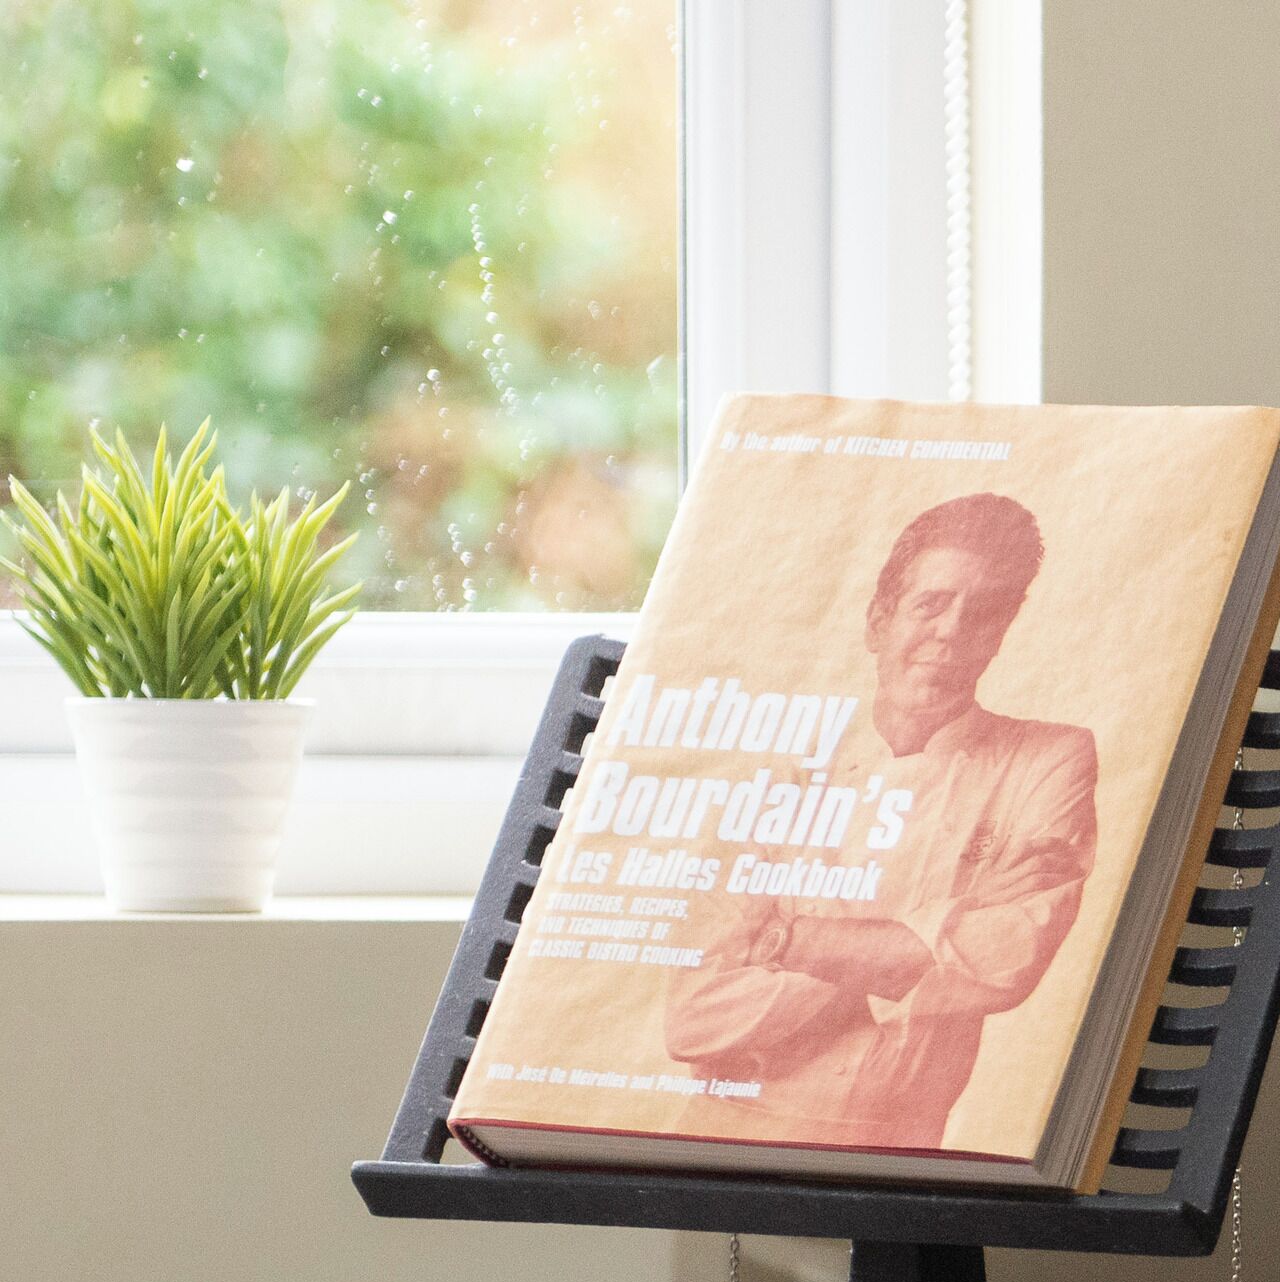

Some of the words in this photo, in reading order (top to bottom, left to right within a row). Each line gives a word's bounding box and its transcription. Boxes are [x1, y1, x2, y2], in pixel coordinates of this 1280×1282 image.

[743, 431, 768, 451] the
[769, 433, 821, 453] author
[823, 436, 844, 455] of
[843, 436, 908, 458] KITCHEN
[910, 440, 1012, 461] CONFIDENTIAL
[606, 674, 859, 769] Anthony
[572, 760, 913, 850] Bourdain's
[555, 844, 613, 884] Les
[616, 847, 721, 892] Halles
[726, 854, 884, 901] Cookbook
[629, 897, 689, 920] RECIPES,
[567, 917, 650, 940] TECHNIQUES
[651, 922, 672, 940] OF
[528, 938, 586, 959] CLASSIC
[587, 942, 640, 962] BISTRO
[640, 945, 704, 968] COOKING
[487, 1063, 515, 1081] With
[630, 1073, 654, 1091] and
[655, 1074, 707, 1097] Philippe
